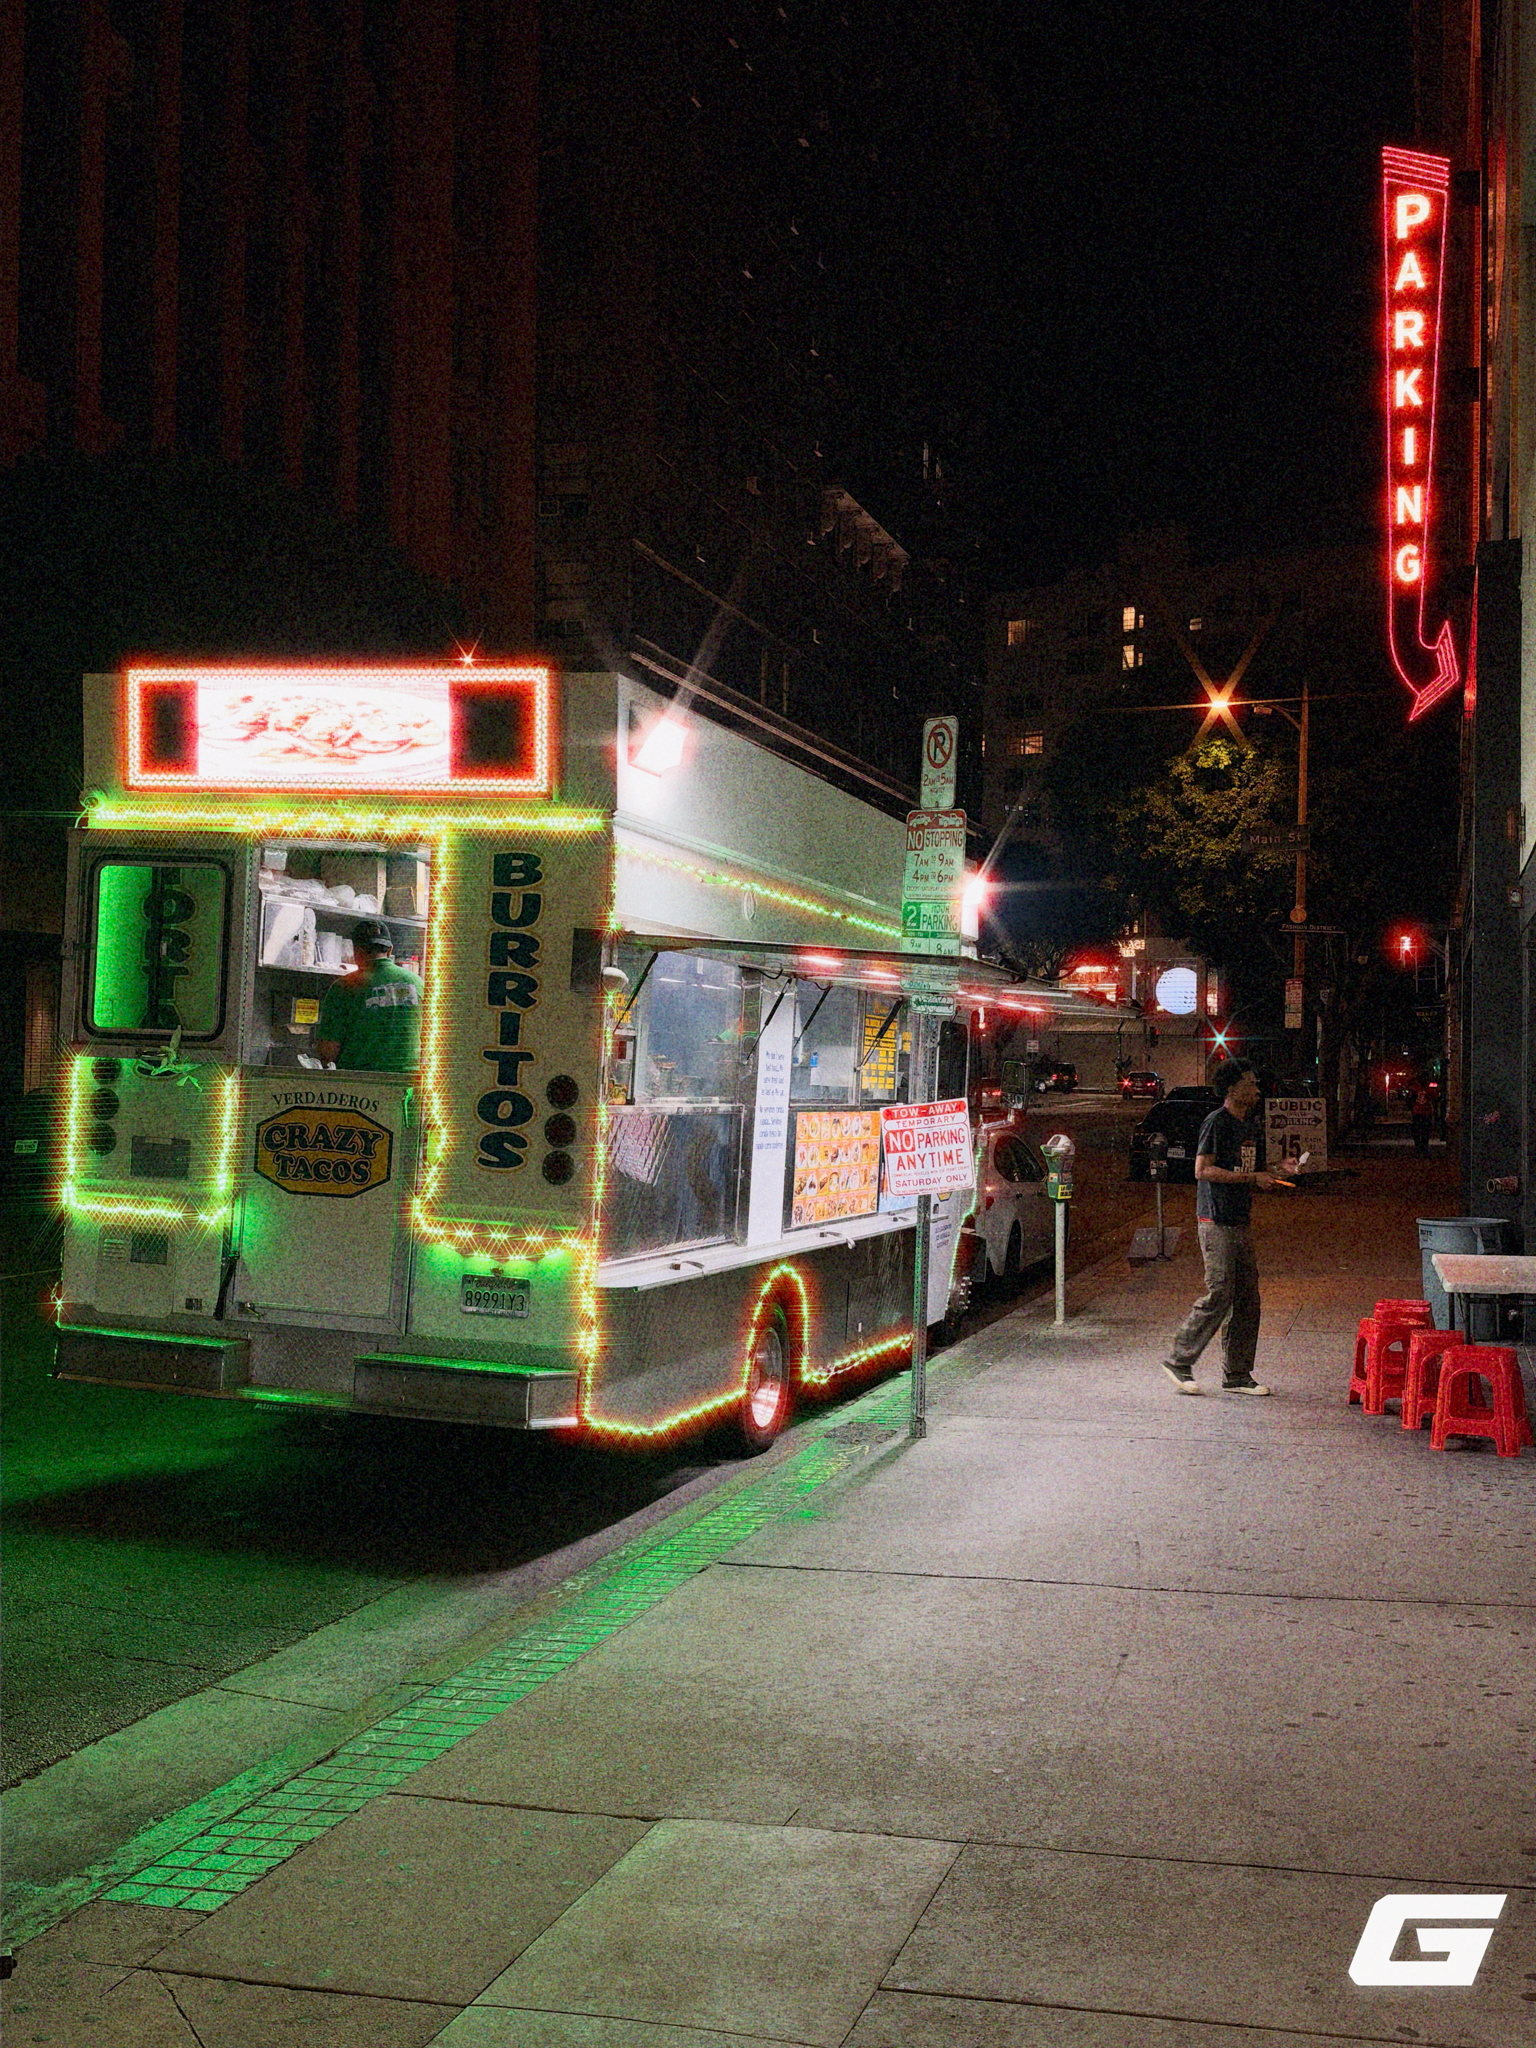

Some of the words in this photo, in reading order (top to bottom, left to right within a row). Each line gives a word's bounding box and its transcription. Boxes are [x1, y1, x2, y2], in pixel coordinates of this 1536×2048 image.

[1394, 193, 1431, 582] PARKING
[907, 830, 924, 850] NO
[925, 831, 963, 848] STOPPING
[914, 853, 929, 867] 7AM
[938, 853, 954, 867] 9AM
[912, 869, 929, 882] 4PM
[937, 869, 953, 883] 6PM
[907, 905, 917, 927] 2
[922, 914, 958, 931] PARKING
[910, 939, 922, 949] 9AM
[476, 852, 543, 1168] BURRITOS
[272, 1091, 380, 1112] VERDADEROS
[892, 1102, 957, 1118] TOW-AWAY
[1268, 1101, 1322, 1111] PUBLIC
[896, 1115, 956, 1128] TEMPORARY
[1275, 1117, 1316, 1126] PARKING
[262, 1122, 384, 1158] CRAZY
[888, 1130, 914, 1152] NO
[917, 1128, 965, 1148] PARKING
[273, 1151, 372, 1185] TACOS
[896, 1148, 964, 1171] ANYTIME
[895, 1177, 942, 1188] SATURDAY
[945, 1173, 967, 1183] ONLY
[465, 1289, 525, 1311] 89991Y3
